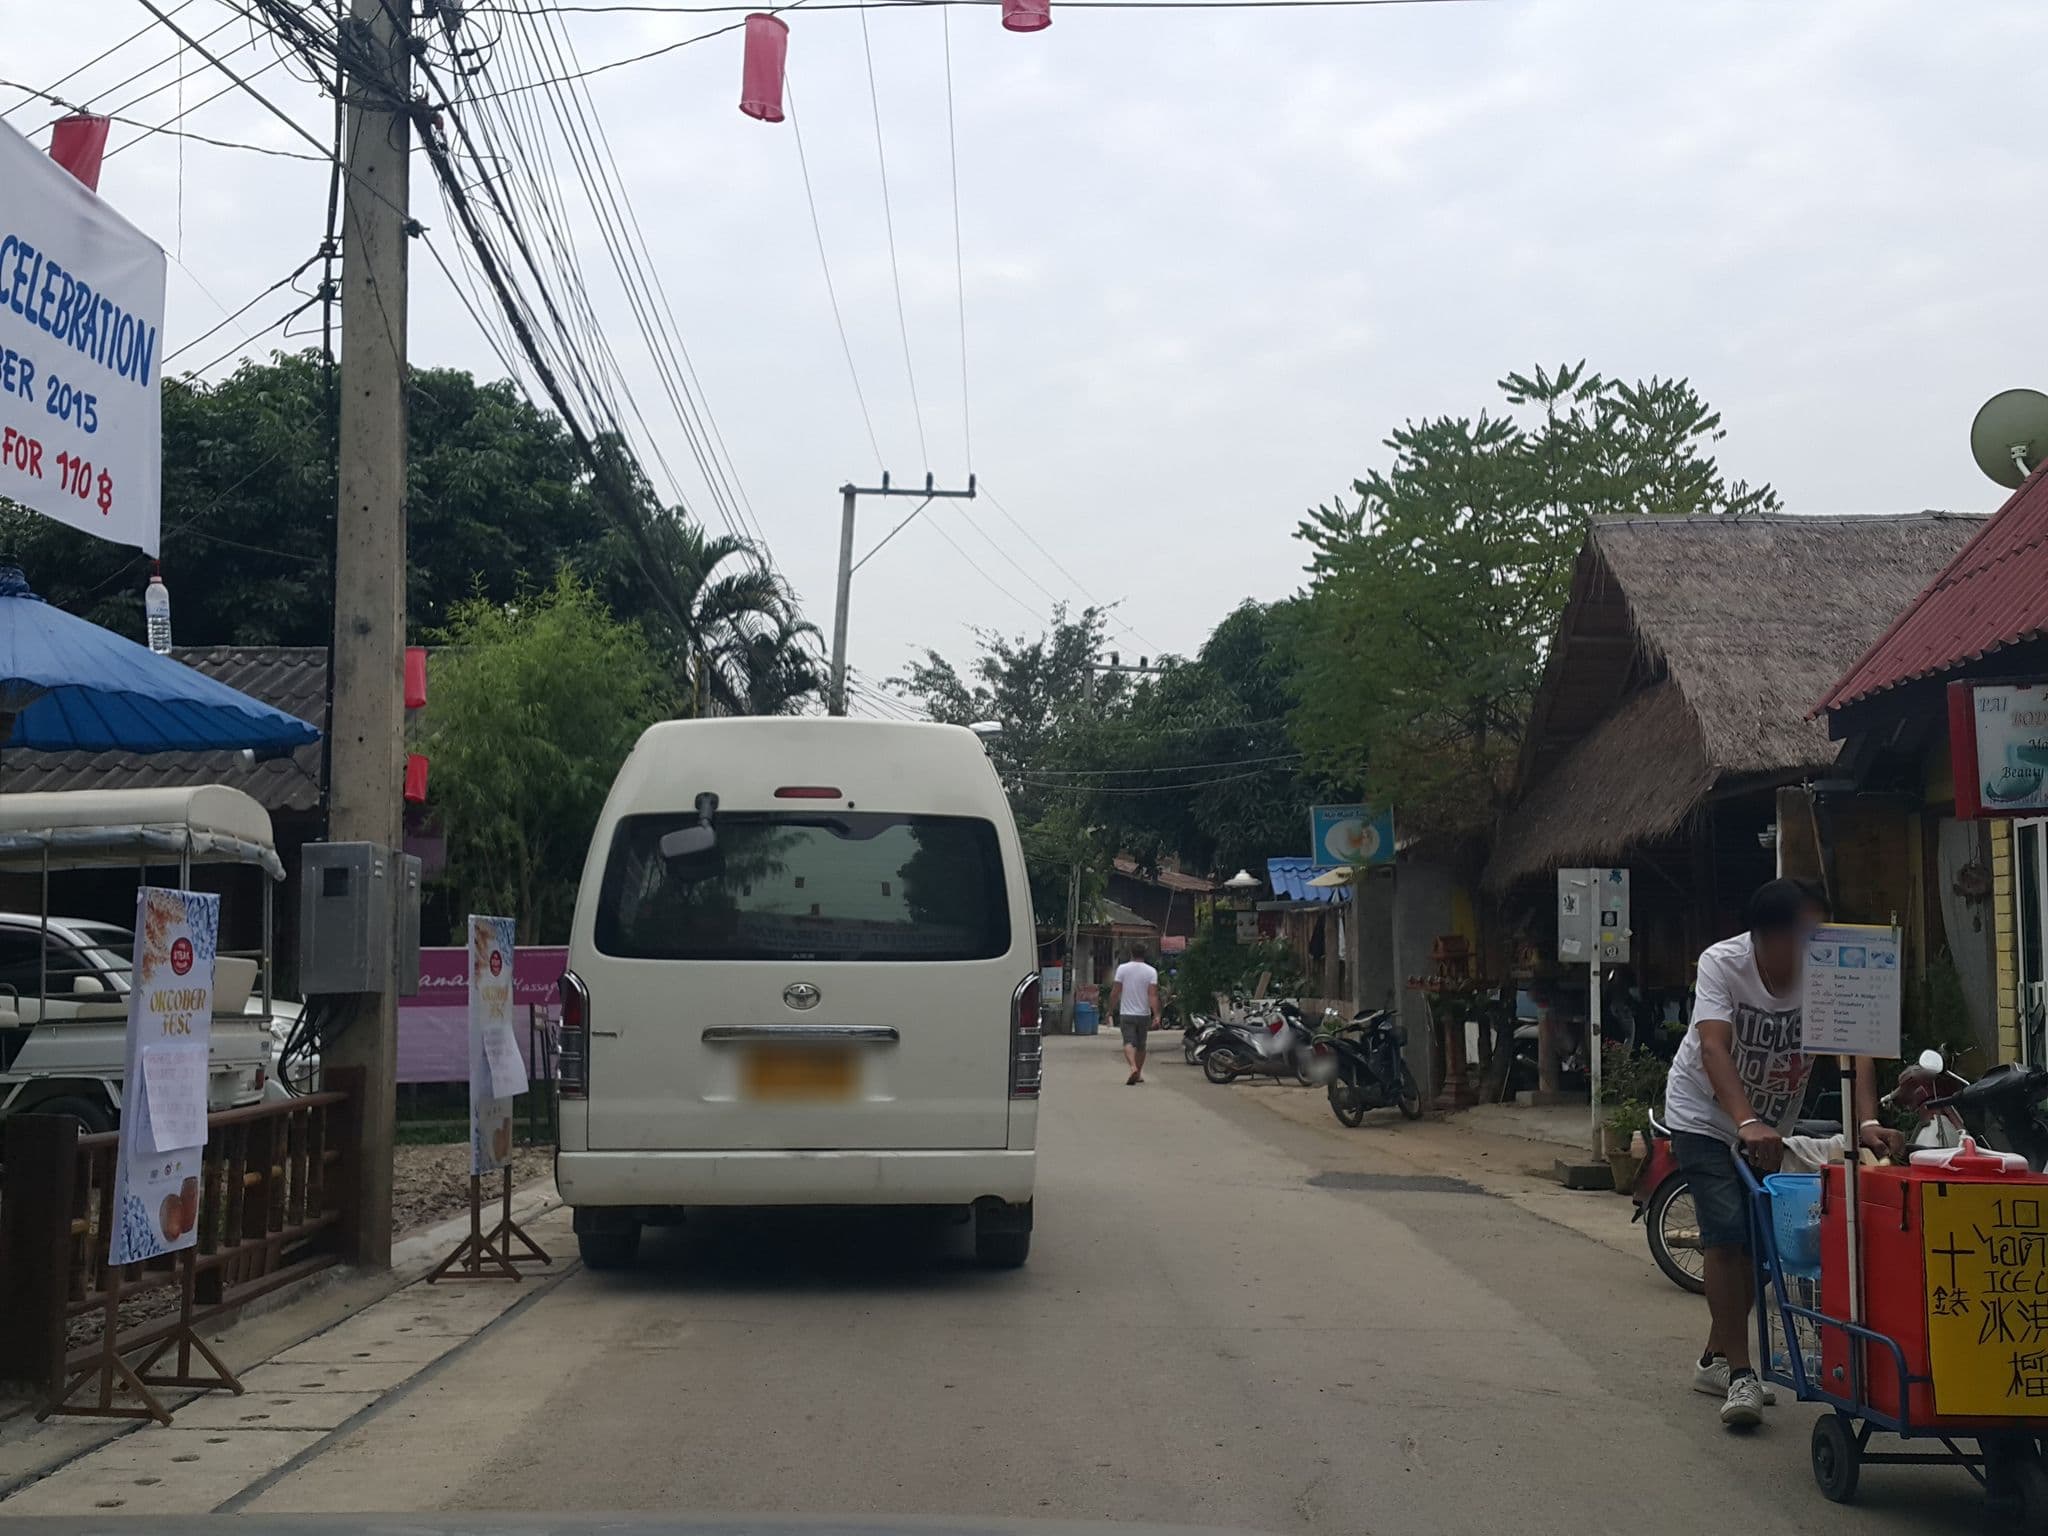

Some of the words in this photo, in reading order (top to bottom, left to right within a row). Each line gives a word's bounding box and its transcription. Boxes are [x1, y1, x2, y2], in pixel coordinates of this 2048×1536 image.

[0, 235, 156, 387] CELEBRATION
[0, 344, 35, 402] ER
[46, 374, 98, 434] 2015
[2, 426, 43, 479] FOR
[56, 451, 92, 499] 110
